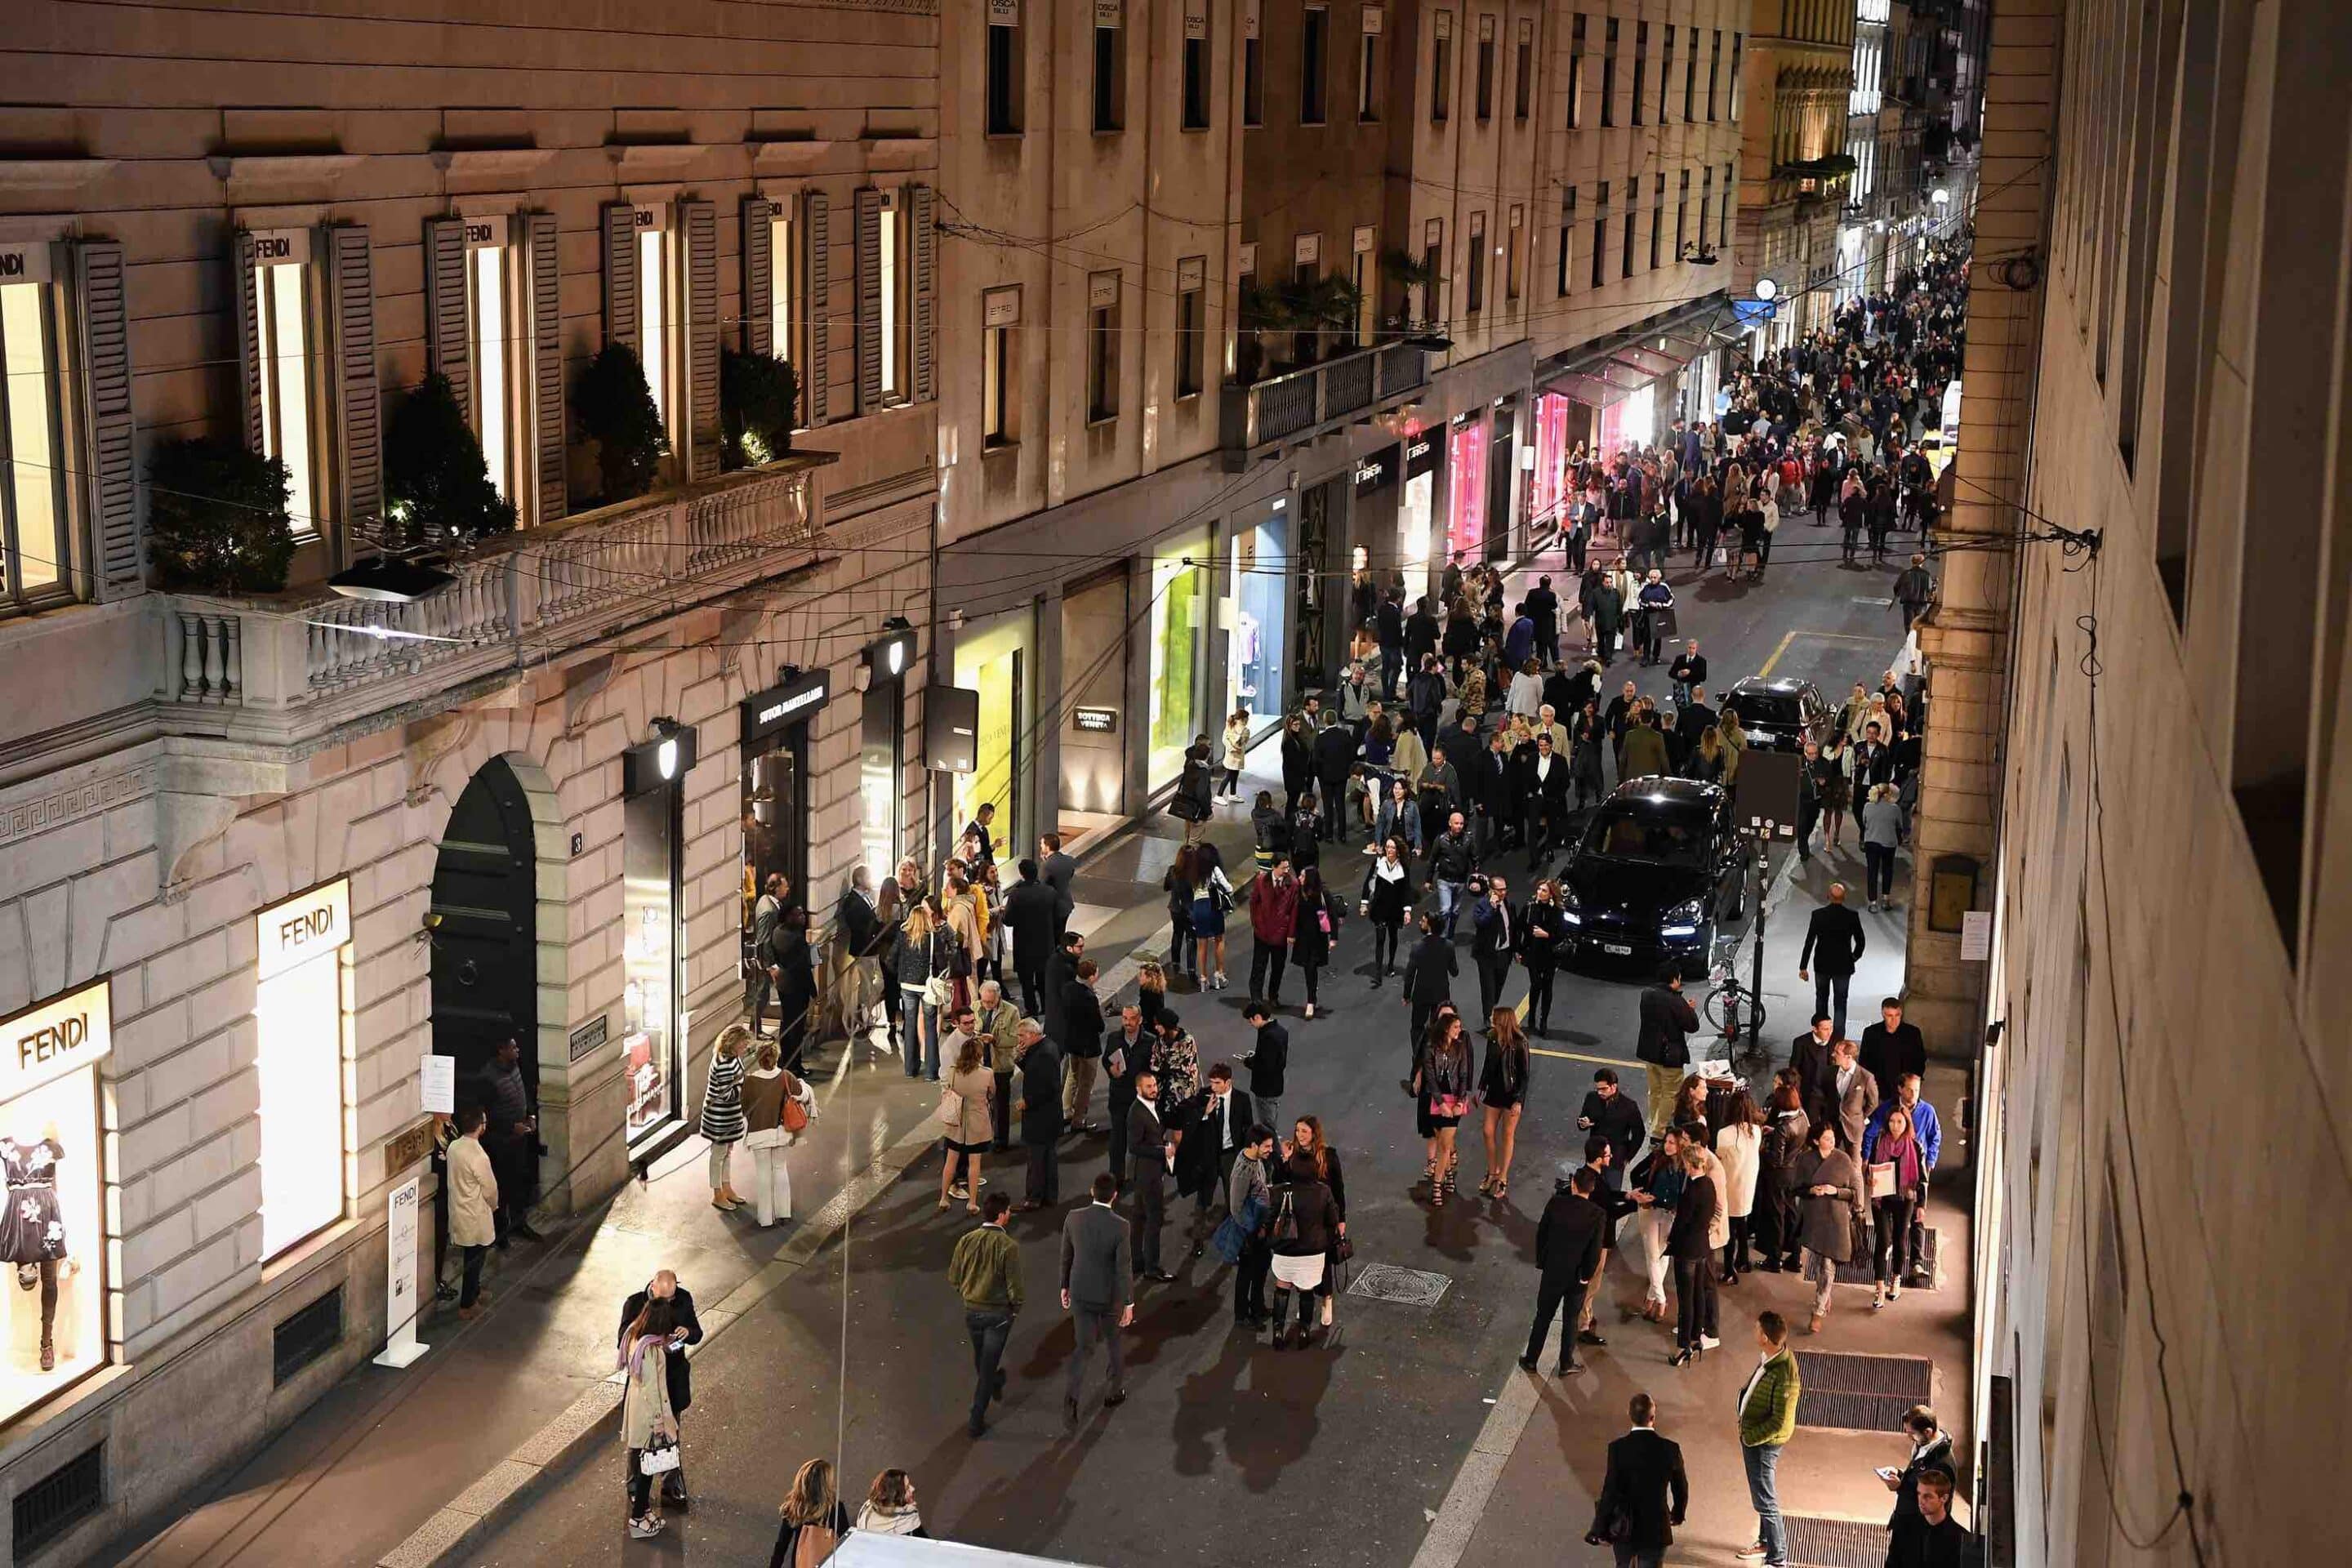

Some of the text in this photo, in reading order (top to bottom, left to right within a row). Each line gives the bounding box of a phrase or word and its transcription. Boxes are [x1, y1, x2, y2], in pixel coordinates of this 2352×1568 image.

[466, 224, 492, 242] FENDI
[256, 238, 290, 258] FENDI
[0, 253, 24, 275] NDI
[279, 904, 333, 952] FENDI
[18, 1012, 87, 1071] FENDI
[394, 1184, 416, 1209] FENDI
